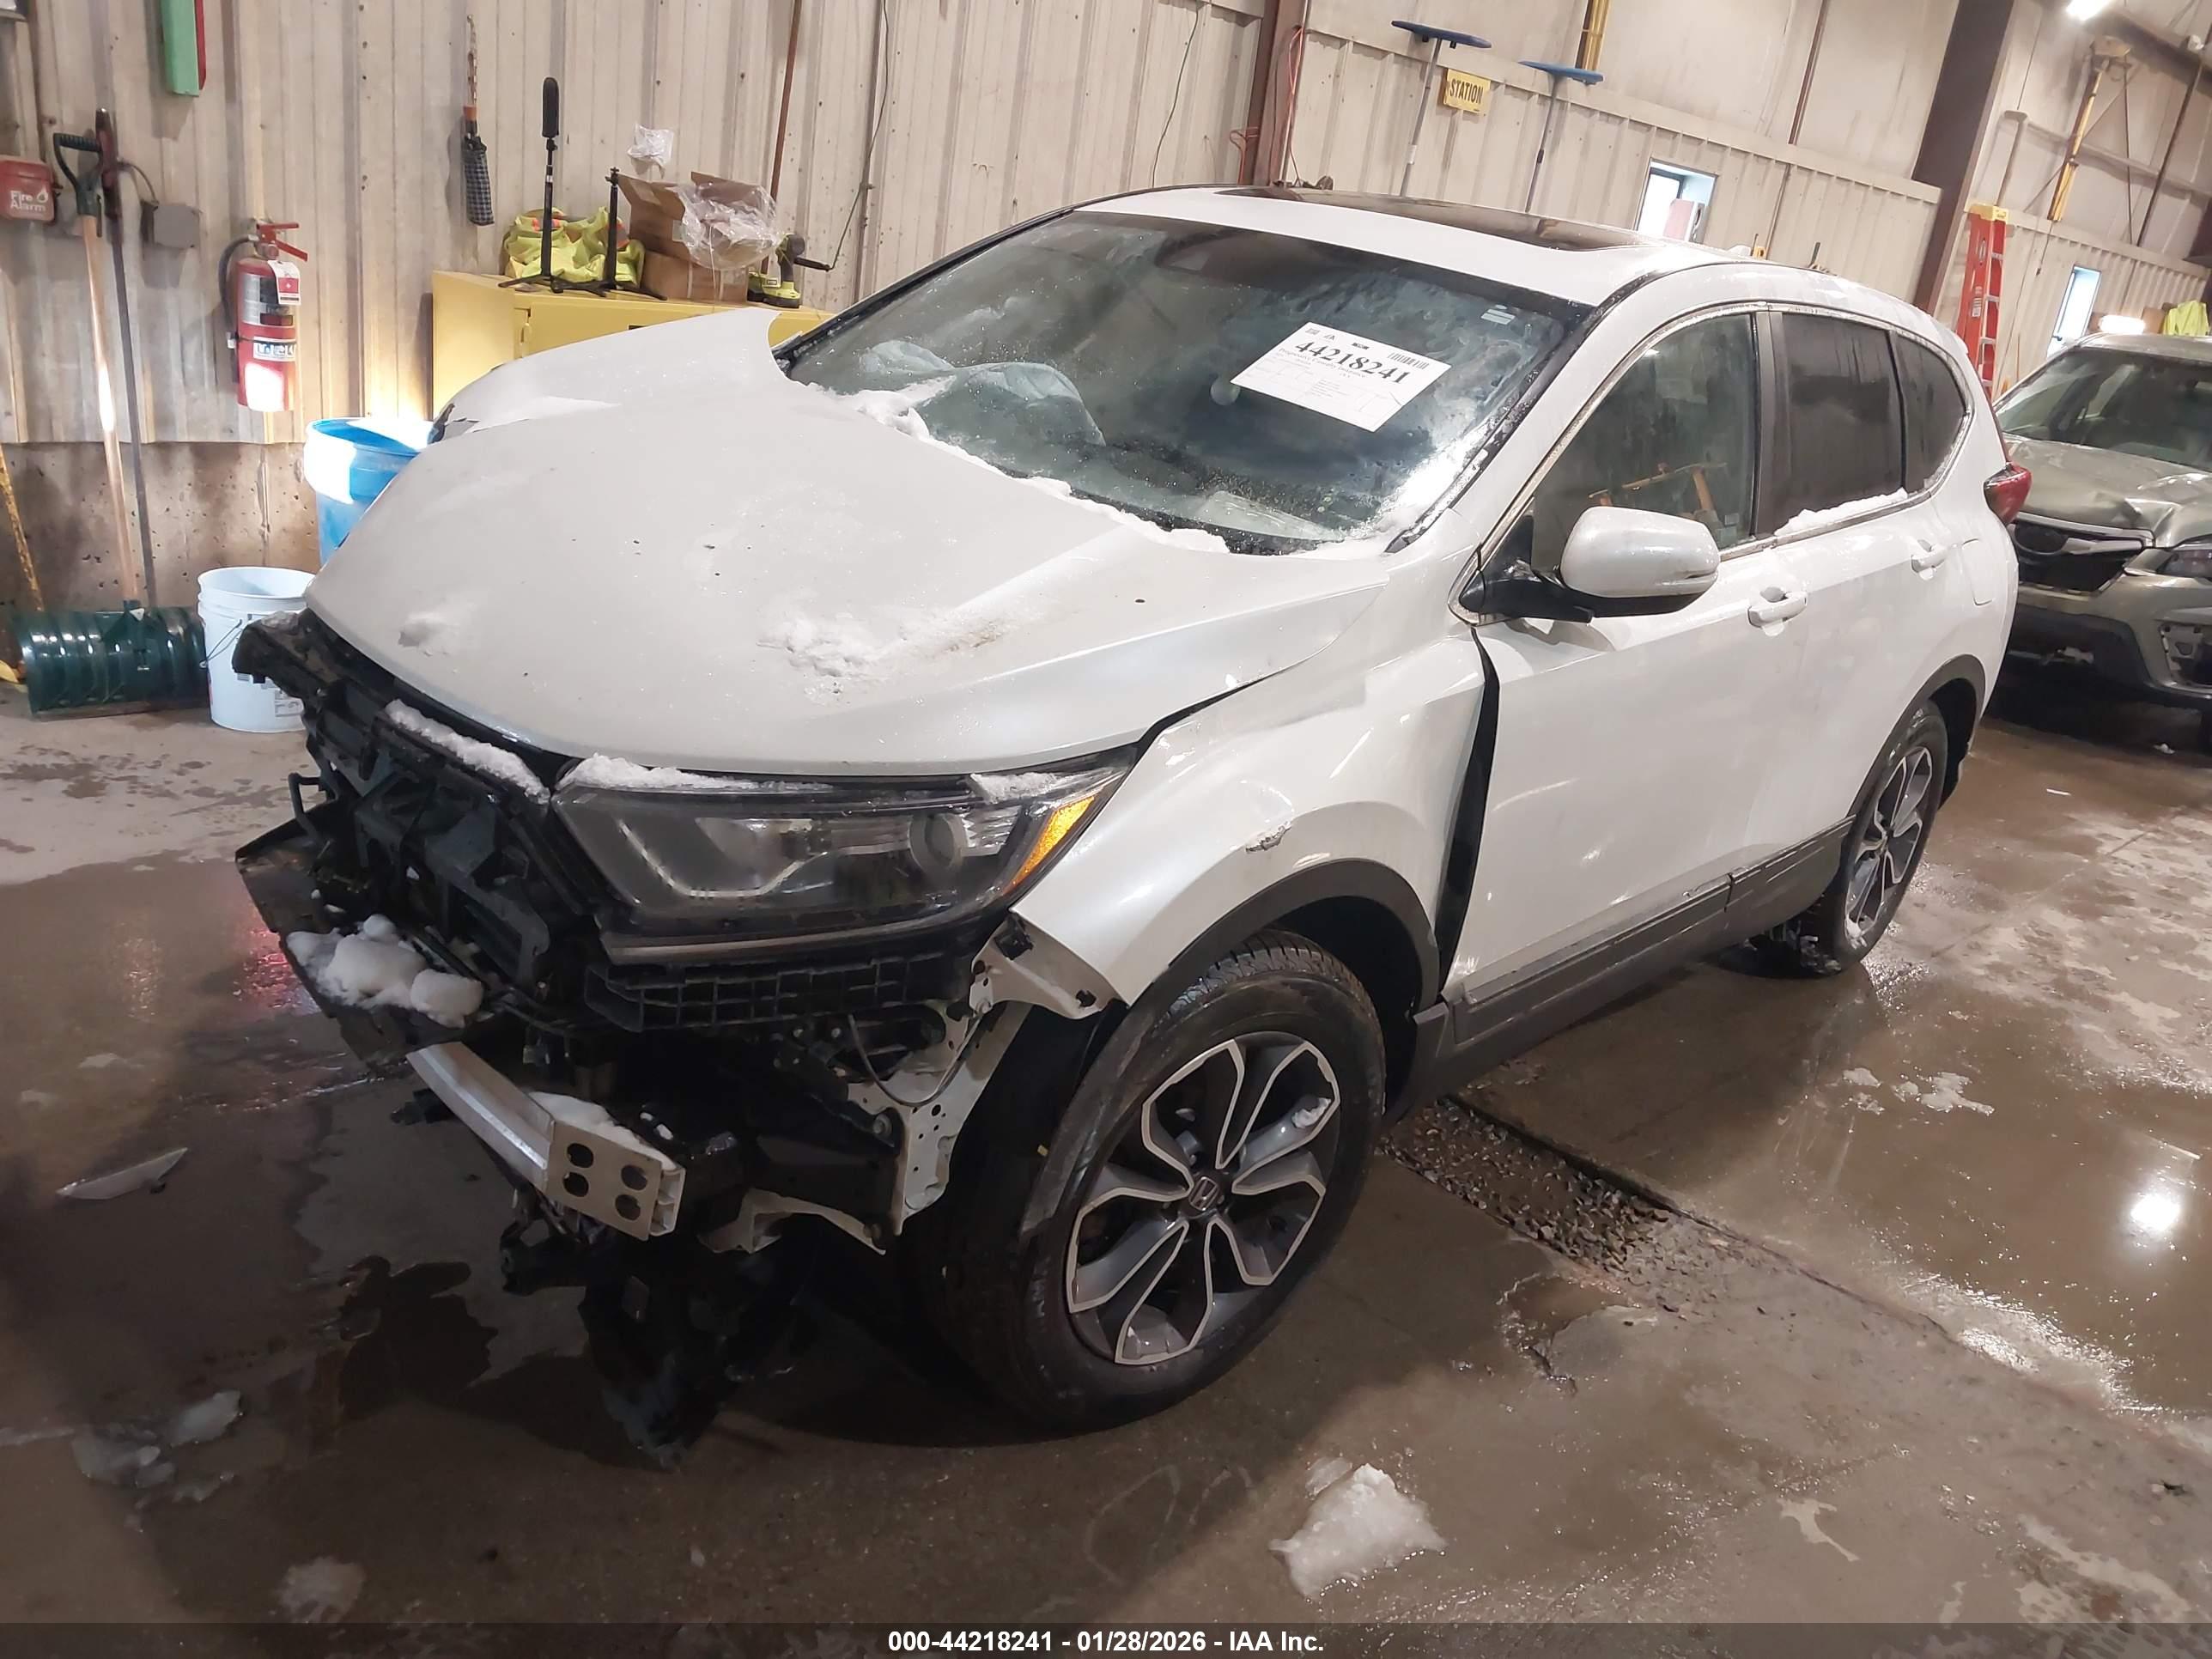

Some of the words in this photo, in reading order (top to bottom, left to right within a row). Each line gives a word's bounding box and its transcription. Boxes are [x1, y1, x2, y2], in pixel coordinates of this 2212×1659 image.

[1449, 78, 1484, 104] STATION
[10, 191, 33, 201] Fire
[10, 199, 46, 211] Alarm
[1295, 342, 1410, 383] 44218241
